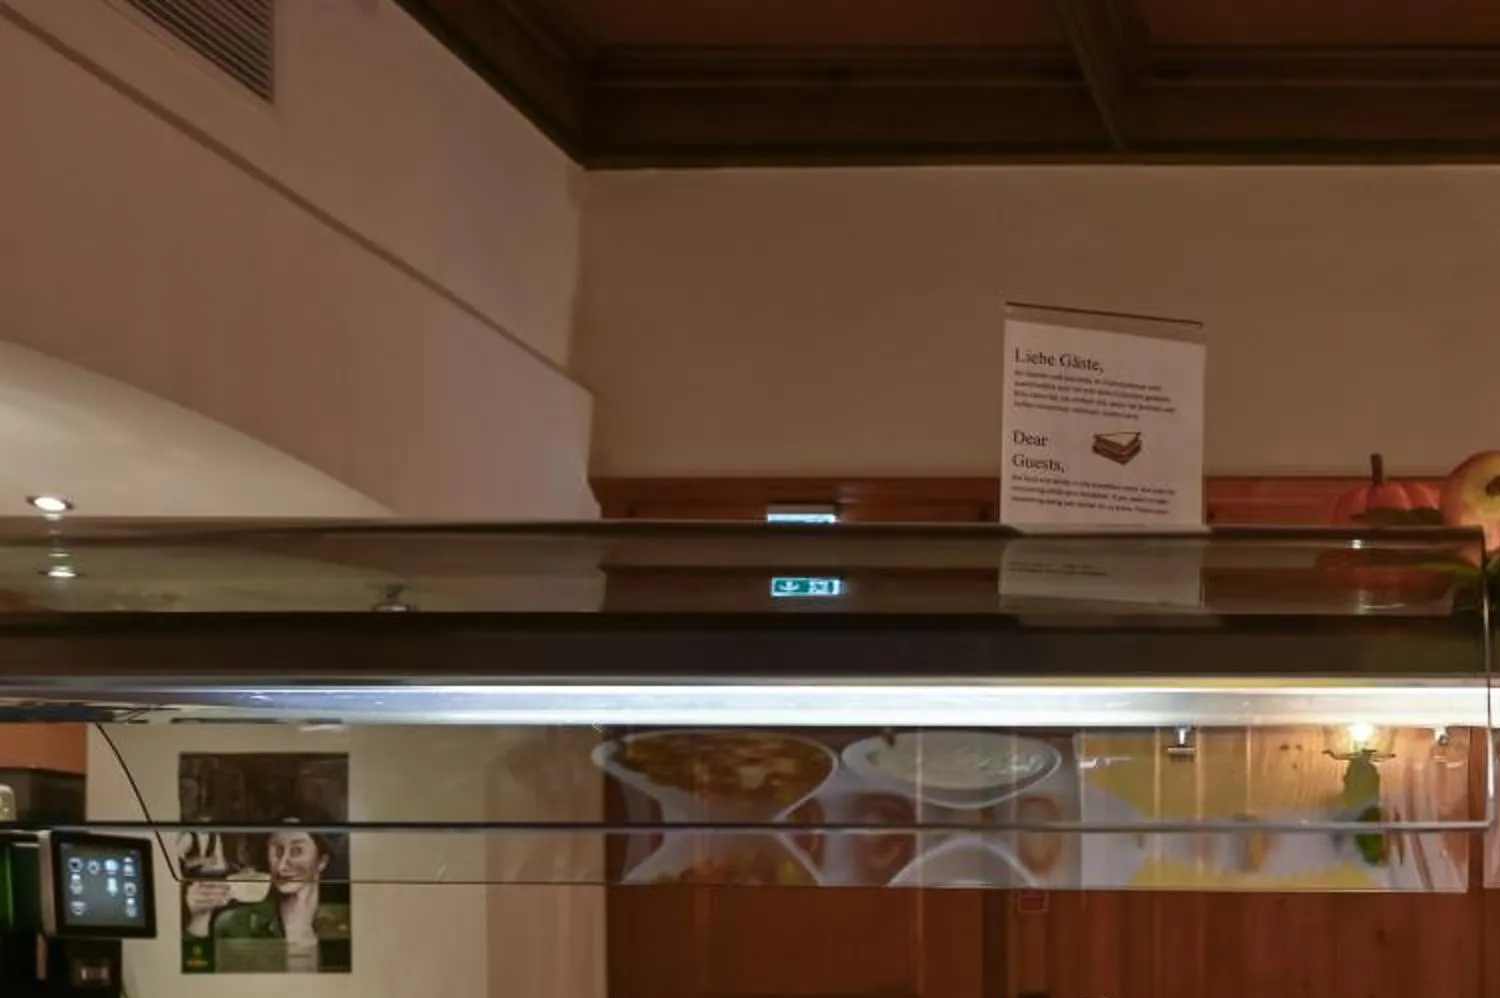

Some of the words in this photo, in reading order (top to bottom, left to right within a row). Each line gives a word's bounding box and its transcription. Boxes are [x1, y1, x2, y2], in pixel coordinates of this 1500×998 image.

[1014, 347, 1055, 367] Liebe
[1059, 353, 1105, 375] Gäste,
[1012, 429, 1049, 448] Dear
[1011, 453, 1065, 474] Guests,
